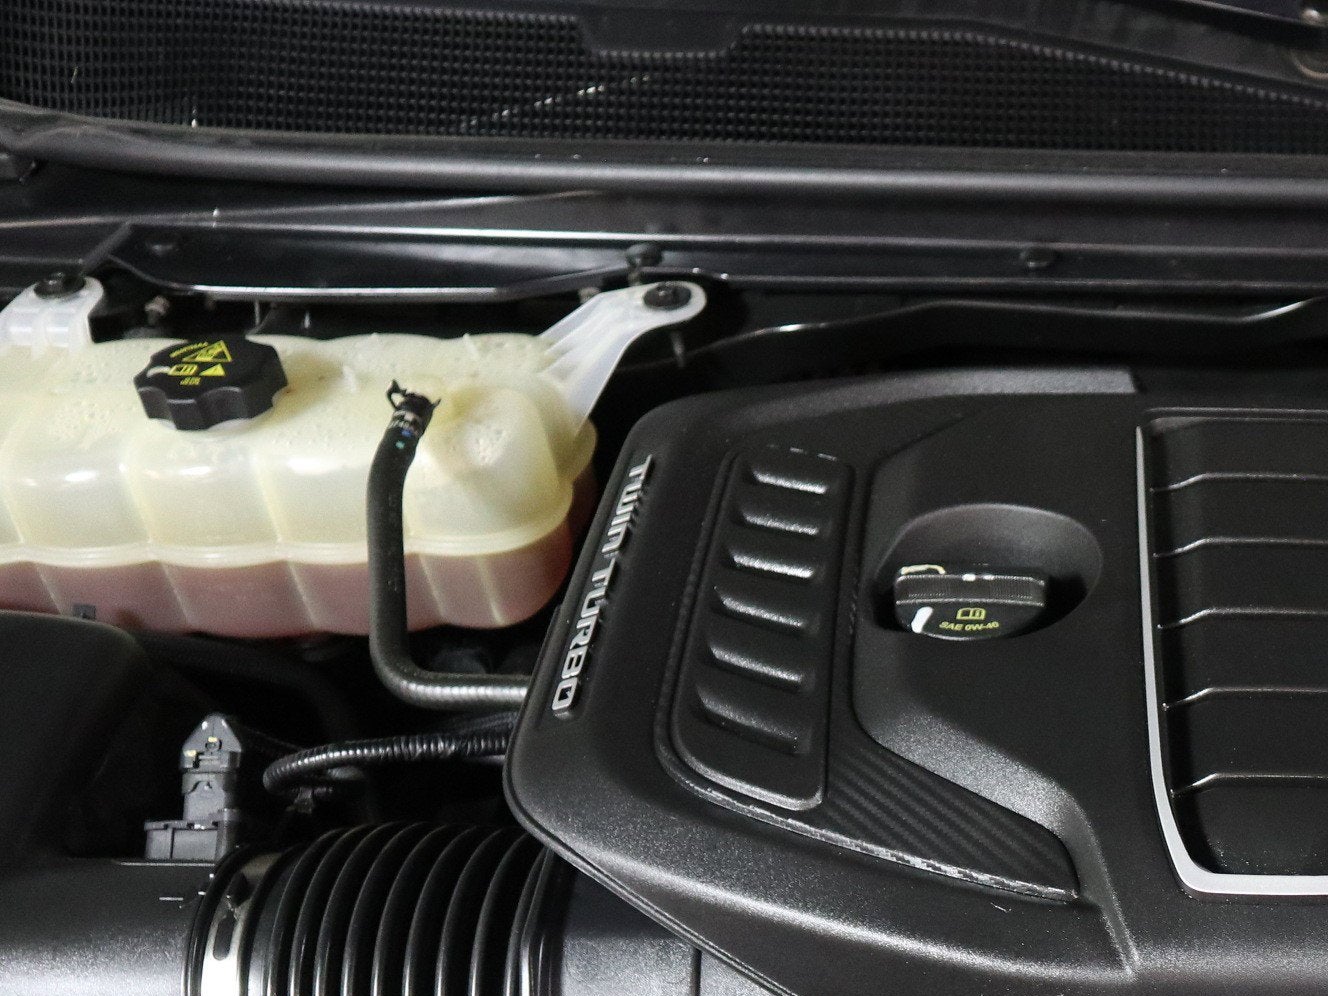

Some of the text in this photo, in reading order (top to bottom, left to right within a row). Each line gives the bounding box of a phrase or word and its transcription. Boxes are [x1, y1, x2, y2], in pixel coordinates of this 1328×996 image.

[552, 454, 652, 711] TWIN TURBO
[939, 621, 964, 631] SAE
